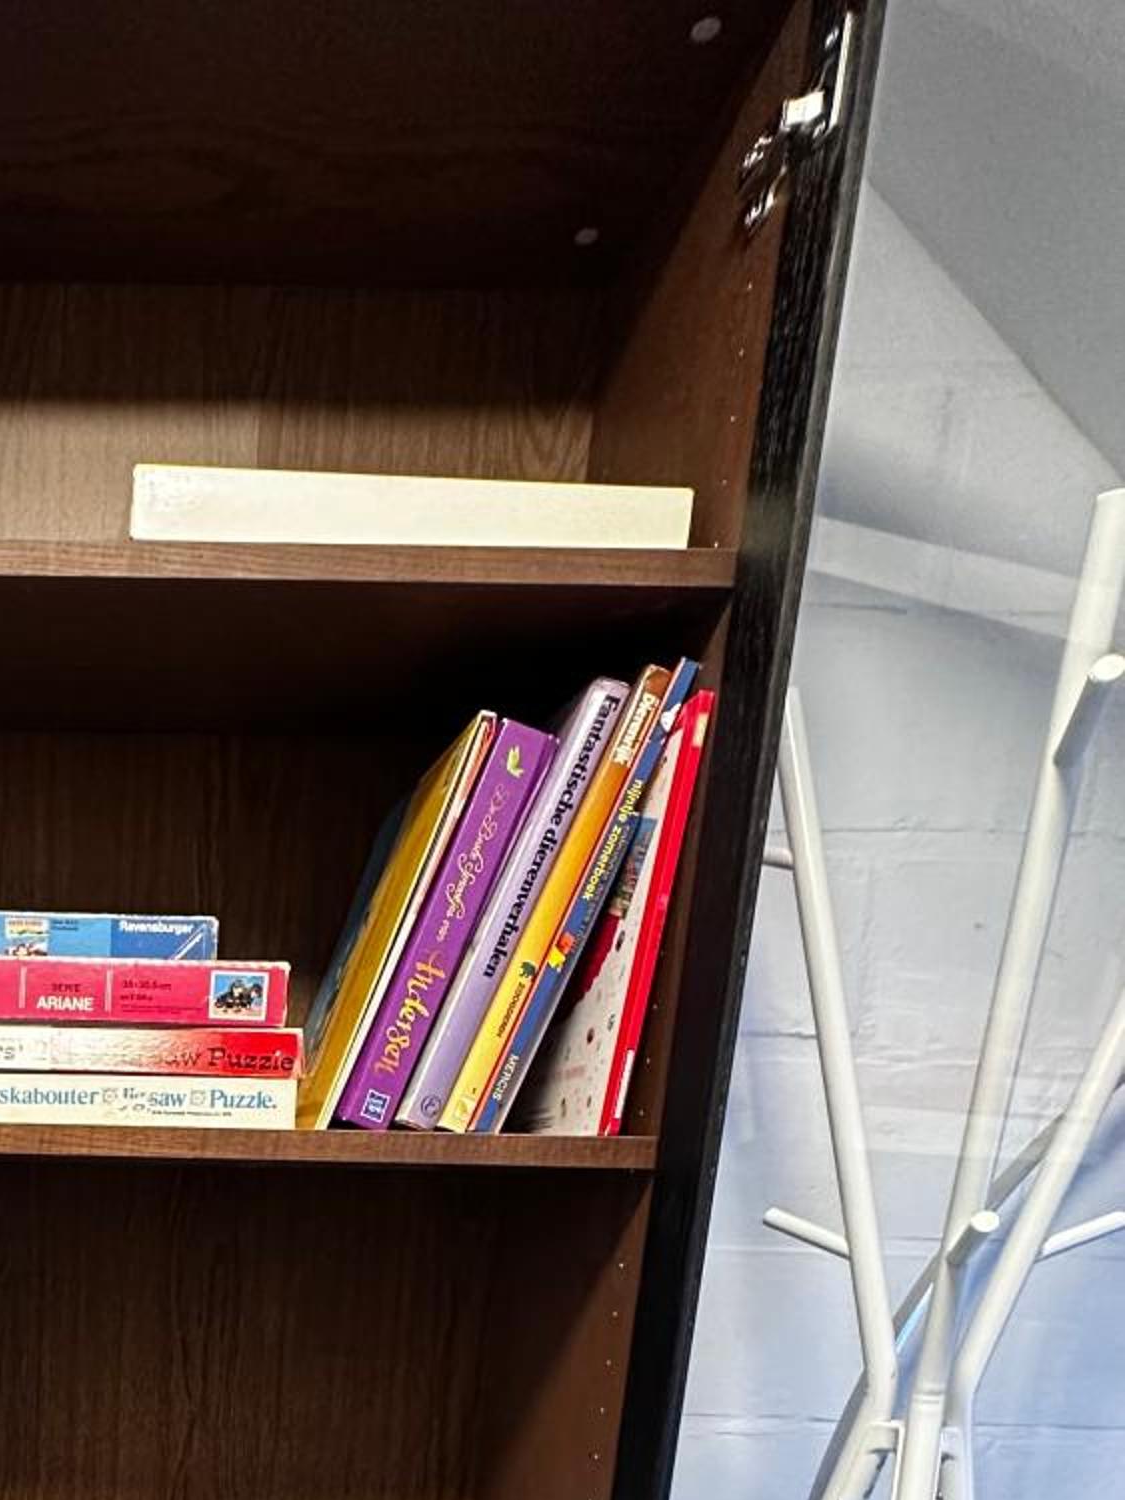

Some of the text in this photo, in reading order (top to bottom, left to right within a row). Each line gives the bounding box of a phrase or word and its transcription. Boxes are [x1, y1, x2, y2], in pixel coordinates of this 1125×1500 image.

[482, 693, 621, 978] Fantastische dierenverhalen
[118, 919, 194, 936] Ravensburger
[36, 996, 95, 1012] ARIANE
[377, 949, 447, 1074] Andersen
[207, 1046, 296, 1072] Puzzle
[492, 1054, 521, 1102] MERCIS
